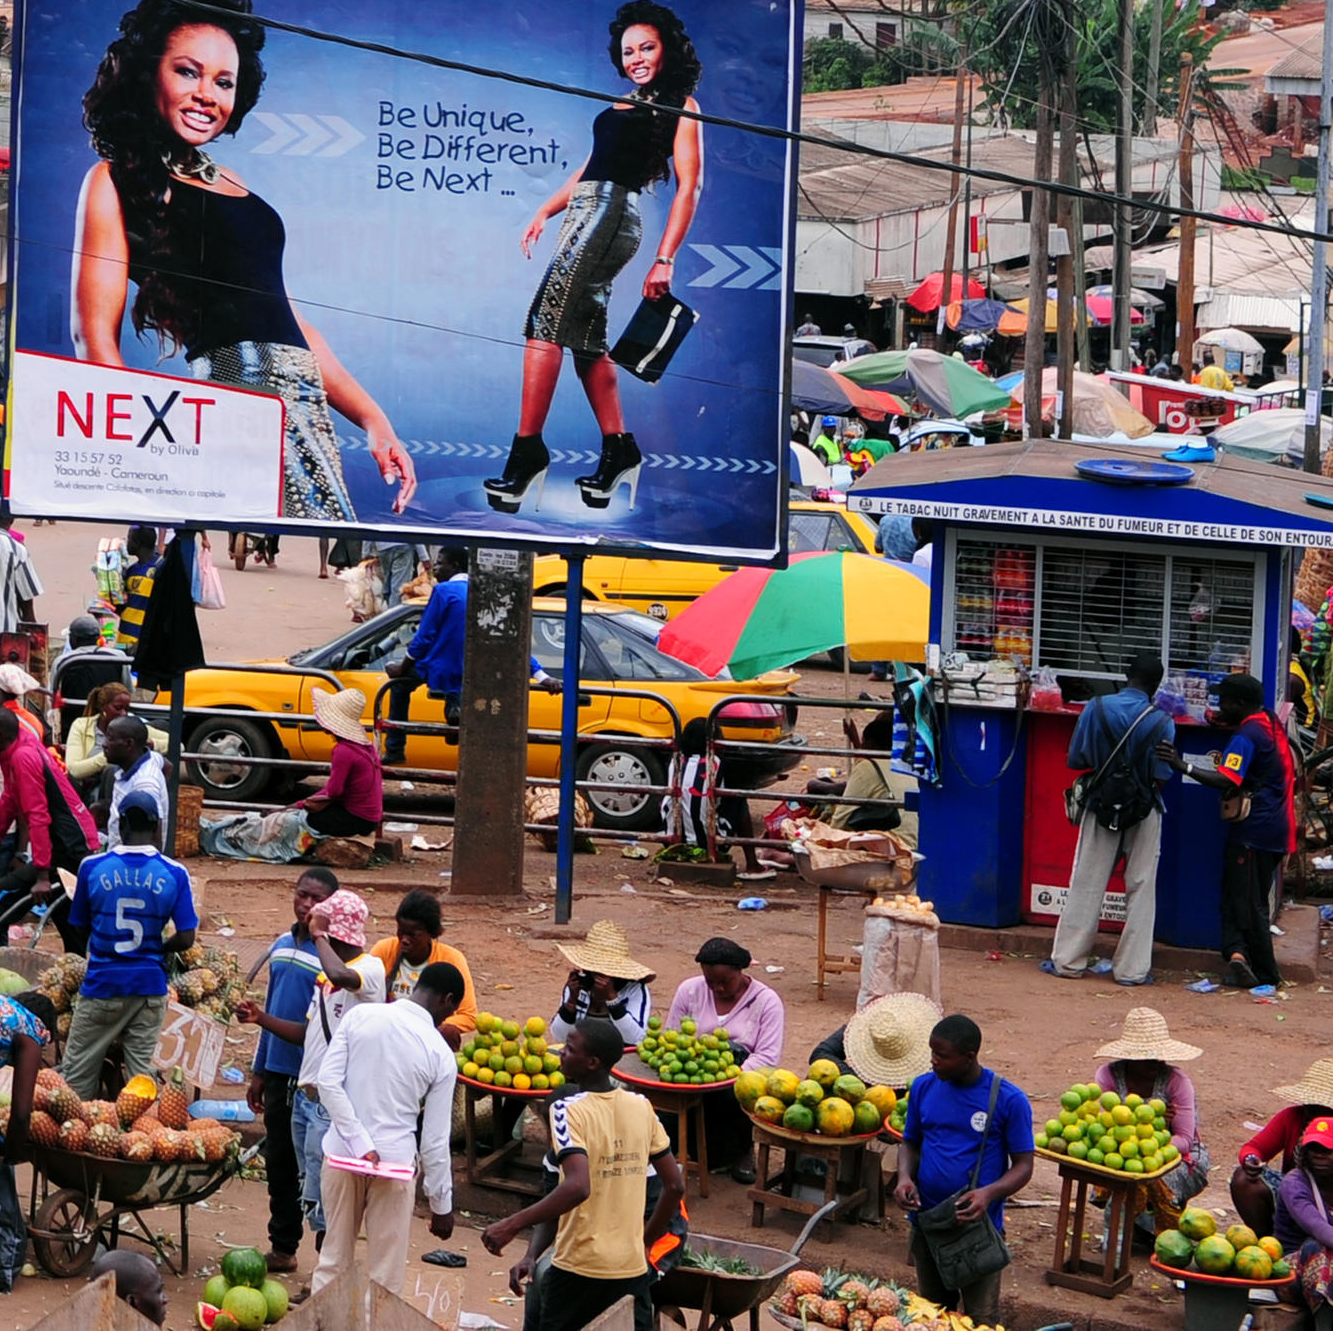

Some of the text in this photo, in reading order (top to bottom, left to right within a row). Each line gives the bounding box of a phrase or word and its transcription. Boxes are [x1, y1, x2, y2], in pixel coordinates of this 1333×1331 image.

[378, 101, 534, 137] Be Unique,
[377, 133, 568, 170] Be Different,
[376, 164, 415, 191] Be
[423, 166, 493, 194] Next
[56, 390, 216, 448] NEXT
[55, 451, 123, 465] 33 15 57 52
[150, 443, 165, 456] by
[54, 465, 101, 479] Yaoundé
[111, 467, 169, 481] Cameroun
[72, 482, 104, 490] descente
[156, 486, 187, 496] direction
[880, 502, 1333, 546] LE TABAC NUIT GRAVEMENT A LA SANTE DU FUMEUR ET DE CELLE DE SON ENTOUR
[99, 868, 166, 895] GALLAS
[114, 897, 146, 954] 5
